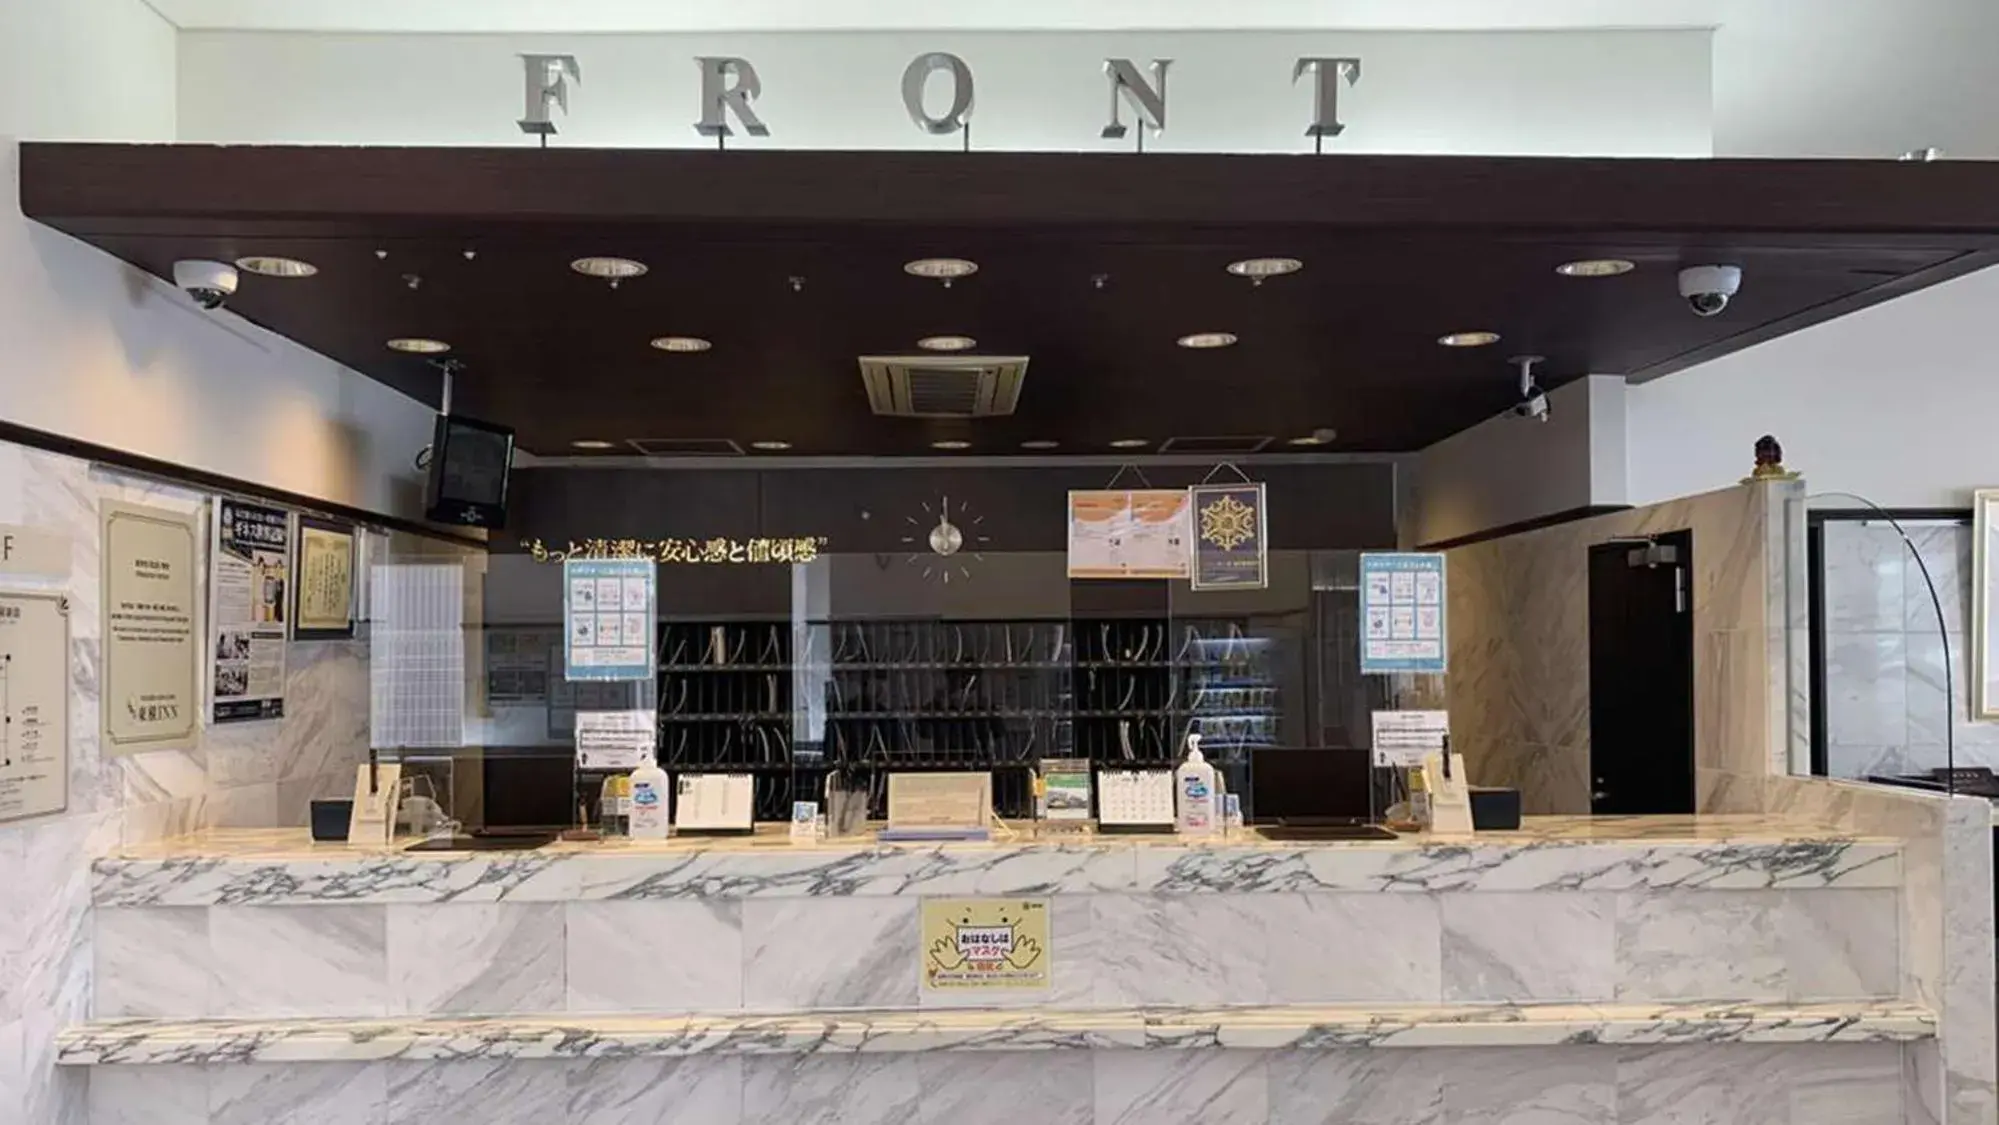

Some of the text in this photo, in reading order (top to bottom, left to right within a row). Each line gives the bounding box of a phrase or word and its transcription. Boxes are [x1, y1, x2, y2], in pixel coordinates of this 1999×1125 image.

[514, 52, 1361, 137] FRONT
[961, 934, 1009, 944] おはなしは
[972, 945, 1000, 956] マスク
